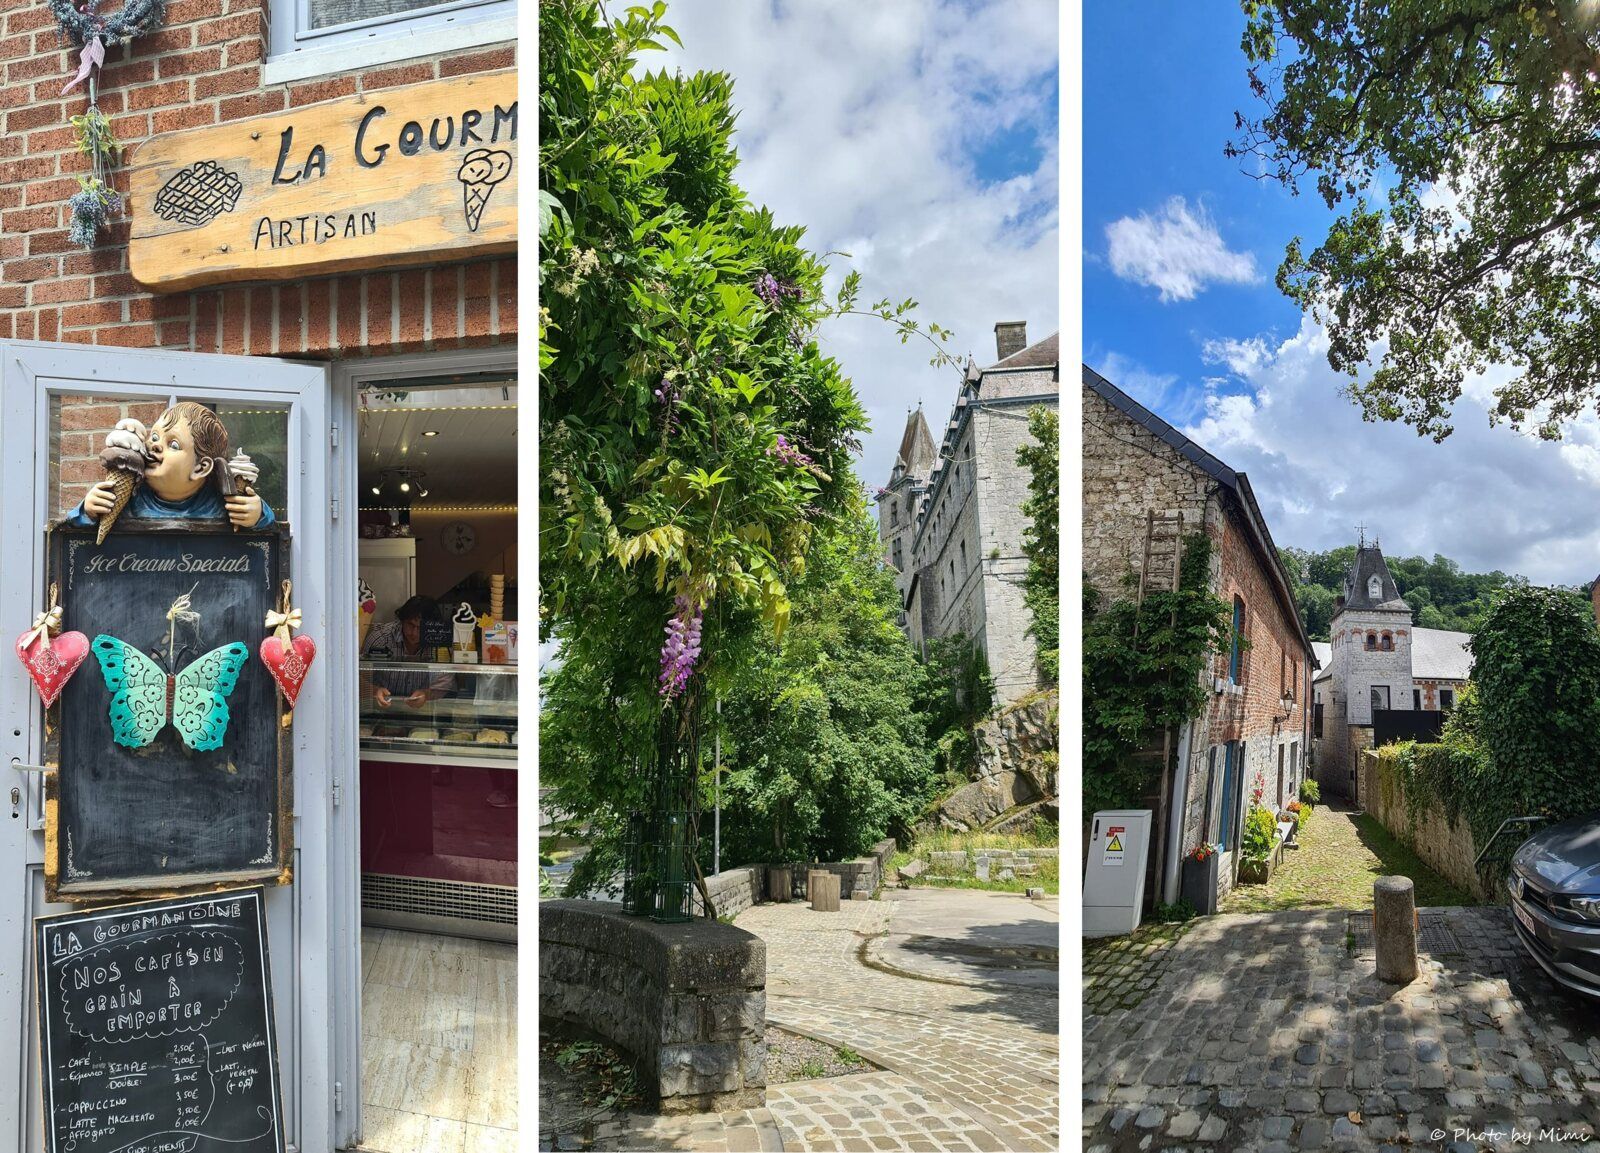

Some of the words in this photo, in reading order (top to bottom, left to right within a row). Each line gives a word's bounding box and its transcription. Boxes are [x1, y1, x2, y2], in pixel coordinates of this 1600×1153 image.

[271, 126, 327, 186] LA
[83, 554, 118, 574] Ice
[118, 553, 176, 573] Cream
[176, 553, 251, 573] Specials
[53, 931, 83, 957] LA
[74, 961, 122, 990] NOS
[135, 942, 199, 972] CAFÉS
[203, 946, 224, 963] EN
[107, 1001, 202, 1032] EMPORTER
[68, 1051, 91, 1068] CAFÉ
[68, 1098, 127, 1114] CAPPUCCINO
[69, 1117, 97, 1129] LATTE
[107, 1112, 155, 1126] MACCHIATO
